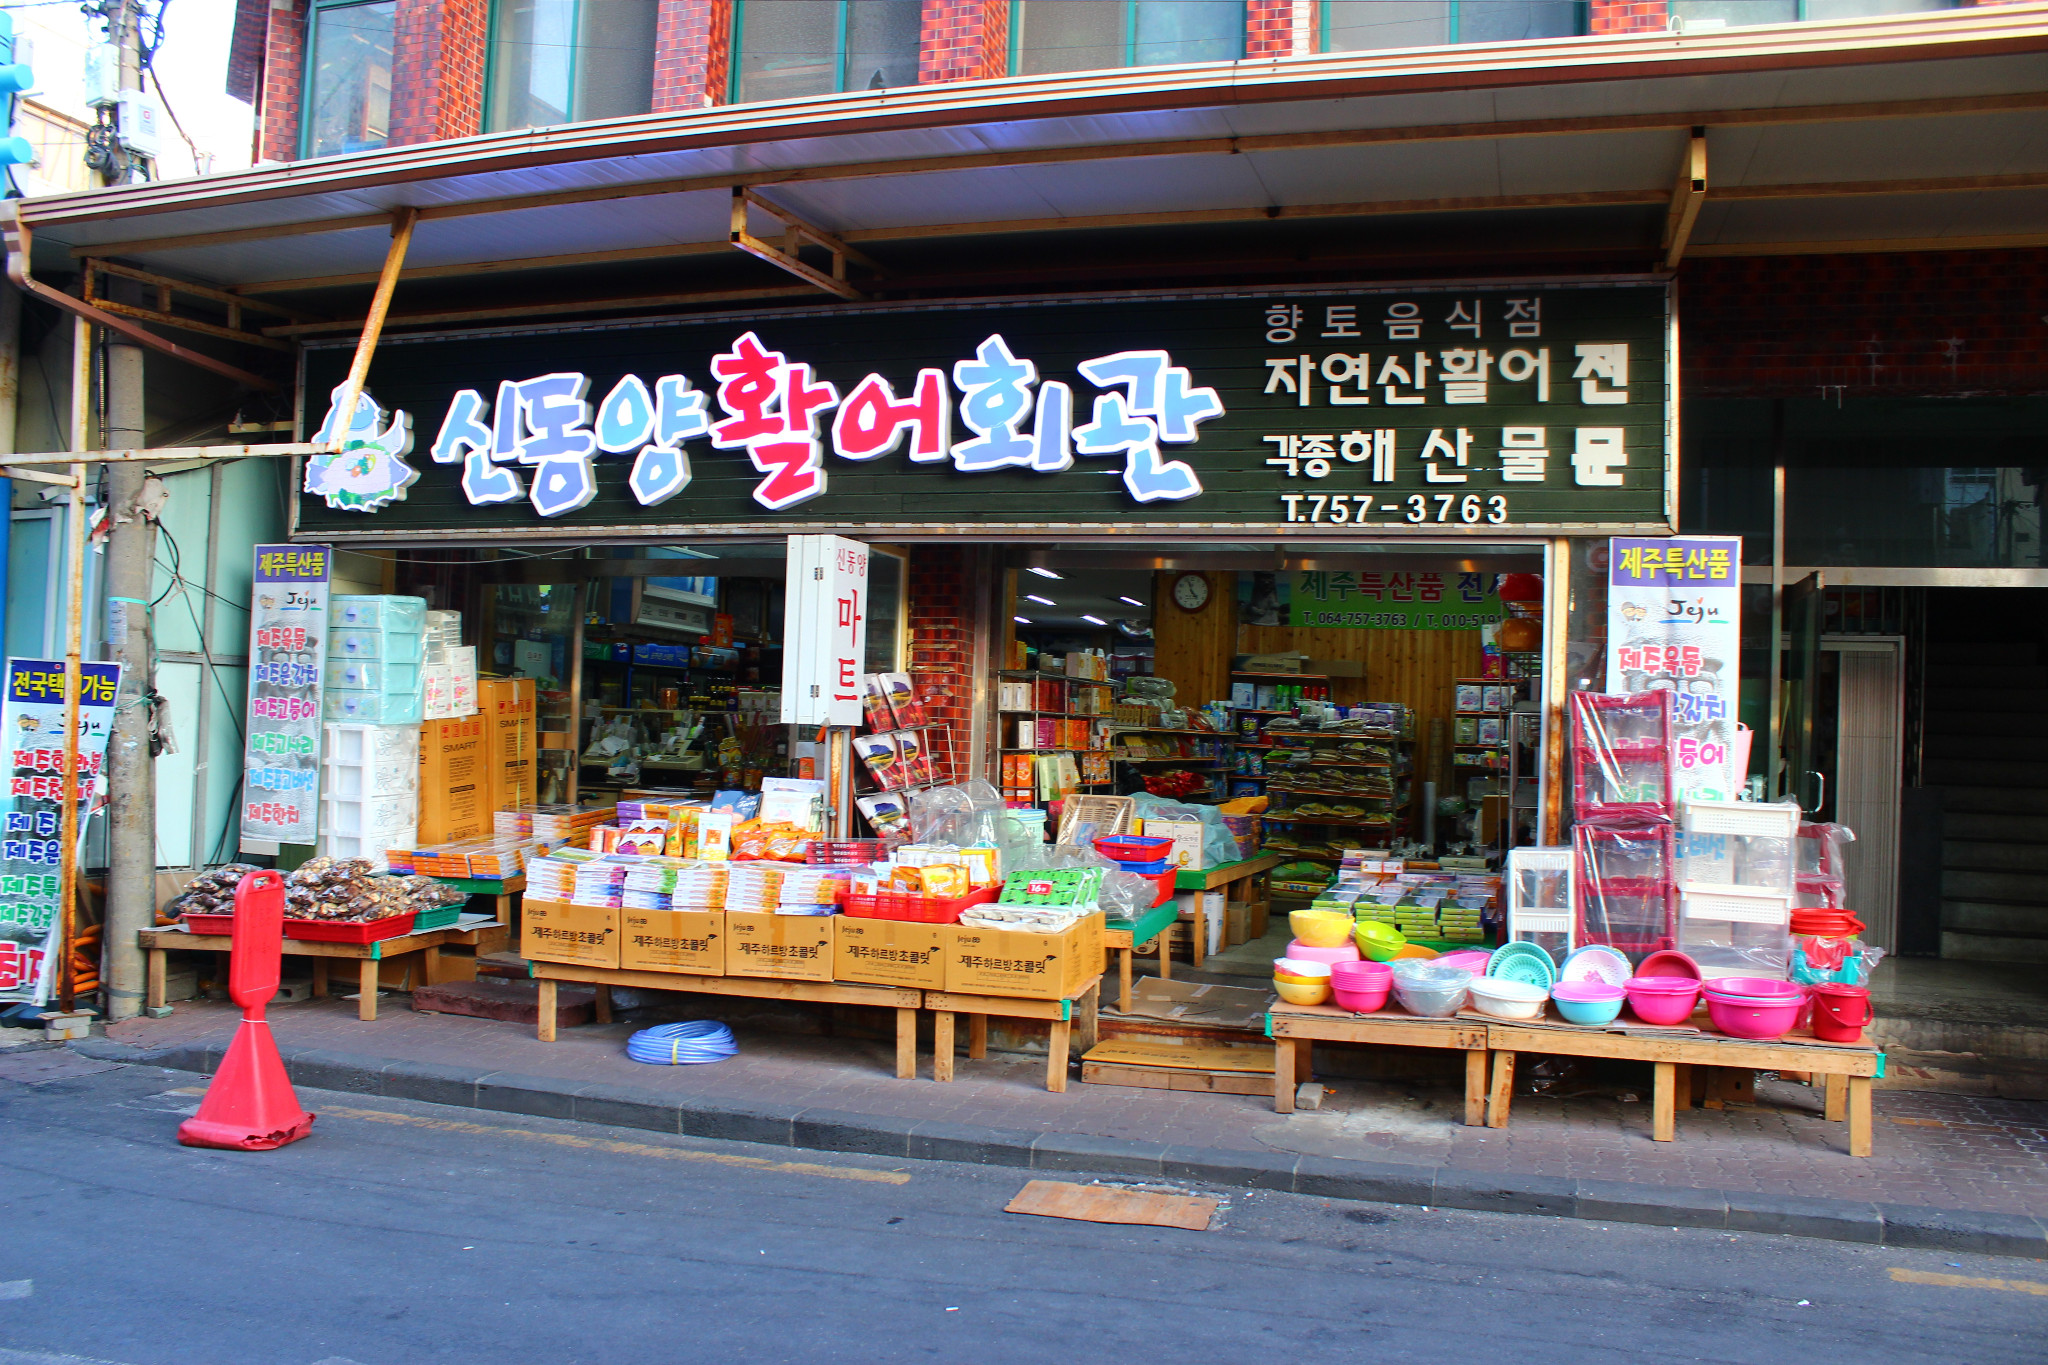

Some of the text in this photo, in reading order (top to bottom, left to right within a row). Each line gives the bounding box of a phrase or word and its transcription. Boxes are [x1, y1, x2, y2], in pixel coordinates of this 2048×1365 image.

[1263, 346, 1550, 406] 자연산활어
[259, 552, 325, 577] 제주특산품
[836, 548, 867, 577] 신동양
[1619, 547, 1731, 580] 제주특산품
[1300, 571, 1445, 602] 제주특산품
[286, 591, 317, 611] Jeju
[1667, 597, 1719, 624] Jeju
[257, 627, 307, 651] 제주옥돔
[834, 588, 862, 702] 마트
[1618, 645, 1702, 676] 제주옥돔
[12, 670, 117, 702] 전국택가능
[254, 697, 316, 722] 제주고등어
[251, 731, 315, 755] 제주고사리
[442, 740, 478, 753] SMART
[248, 802, 300, 826] 제주한치
